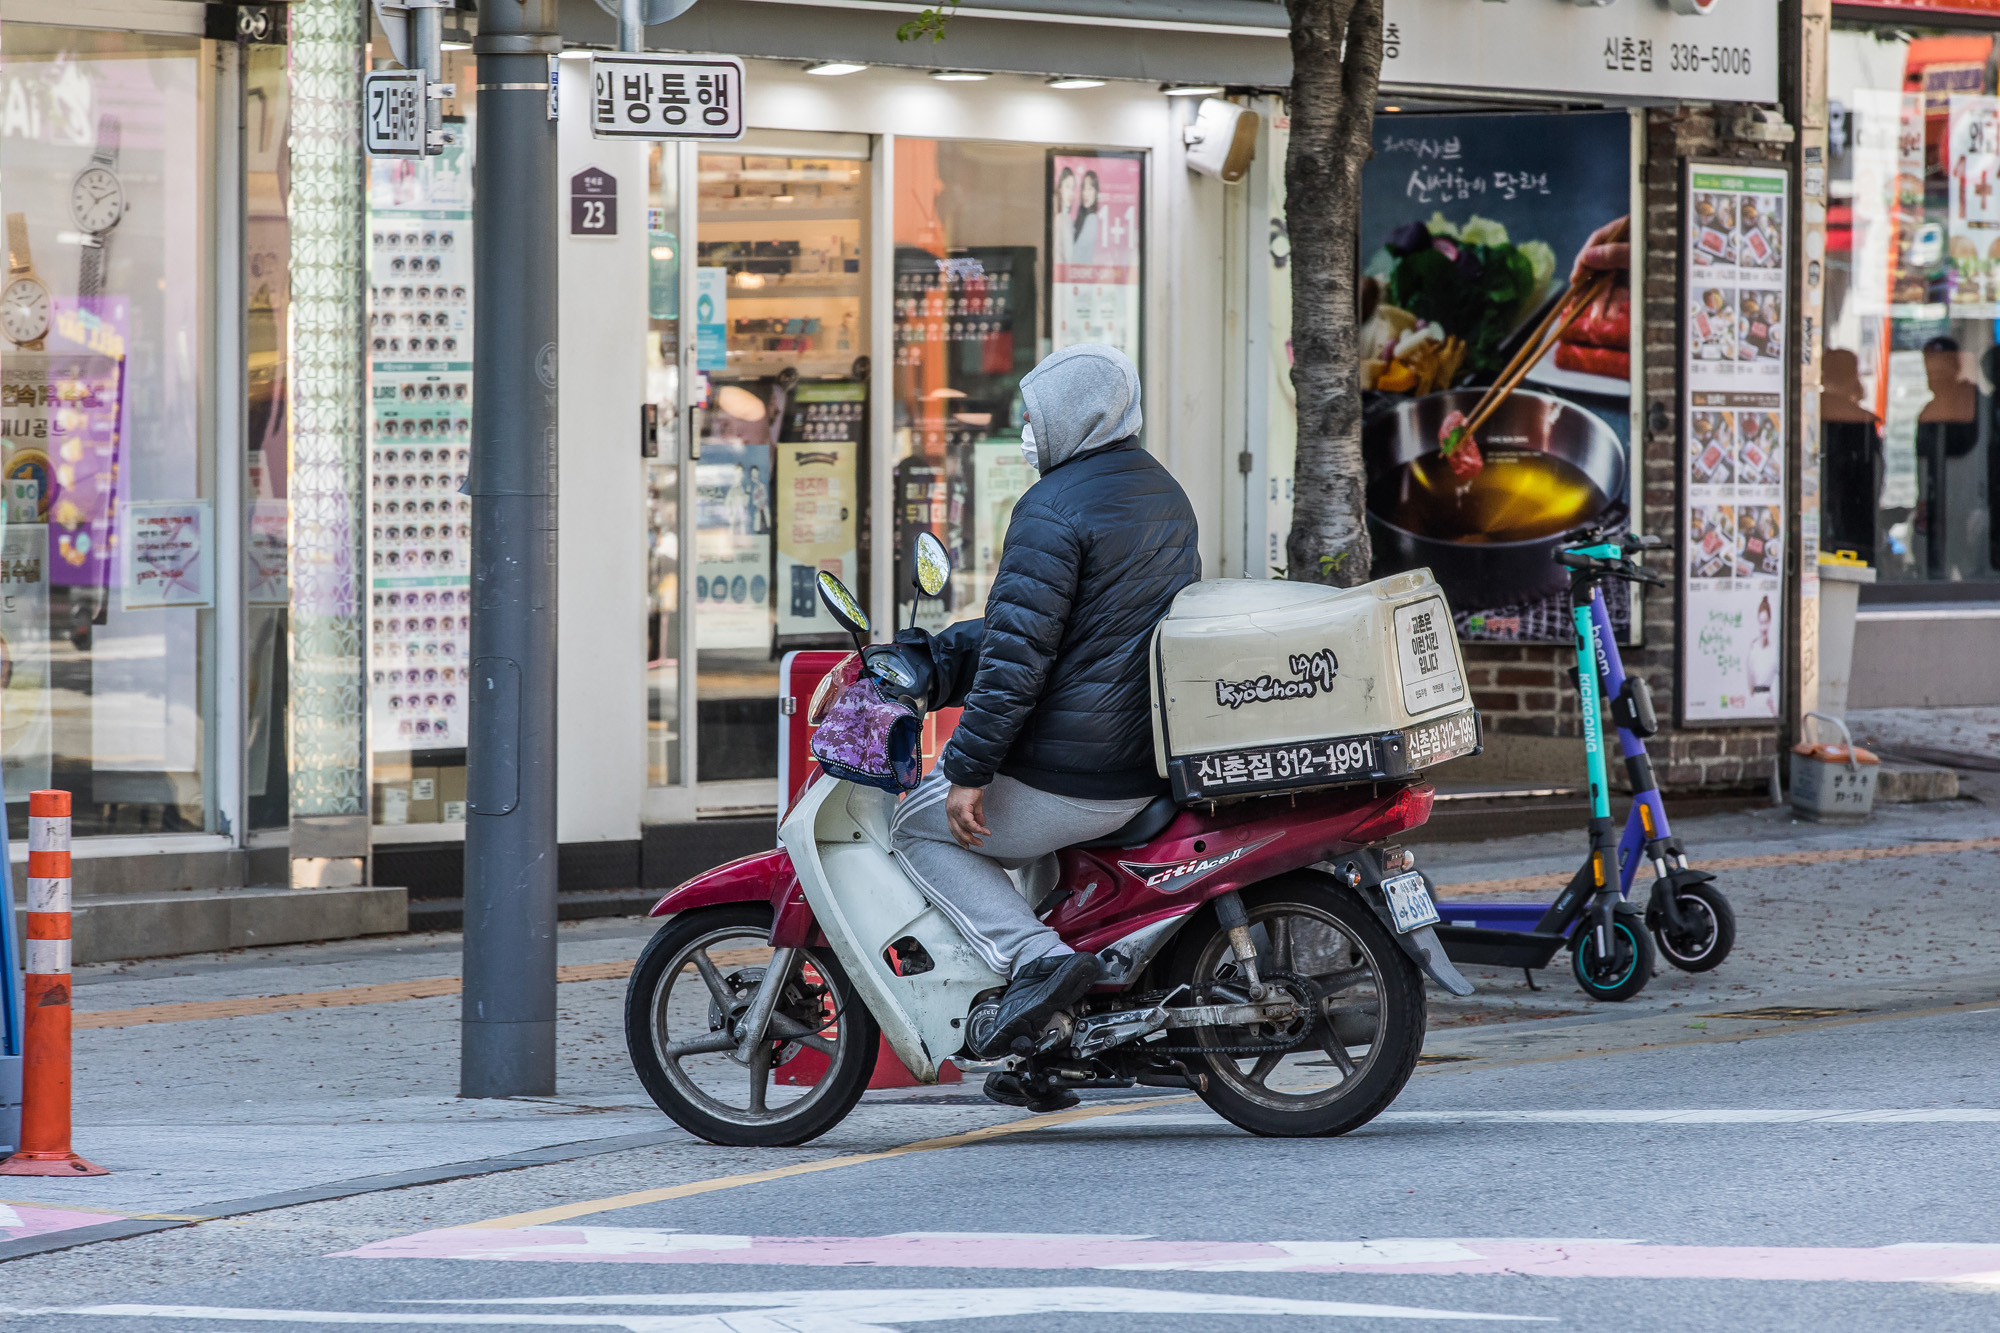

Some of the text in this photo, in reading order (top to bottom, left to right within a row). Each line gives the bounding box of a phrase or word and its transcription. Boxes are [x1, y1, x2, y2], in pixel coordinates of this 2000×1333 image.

[1604, 37, 1751, 75] 신촌점 336-5006
[596, 70, 729, 126] 일방통행
[582, 200, 605, 229] 23
[1098, 204, 1138, 250] 1+1
[1410, 612, 1433, 635] 교촌은
[1411, 631, 1440, 656] 이런 치킨
[1418, 652, 1439, 675] 입니다
[1578, 673, 1598, 753] KICKGOING
[1408, 714, 1477, 760] 신촌점 312-1991
[1198, 740, 1374, 787] 신촌점 312-1991
[1193, 854, 1231, 875] Ace
[1407, 892, 1435, 920] 6897
